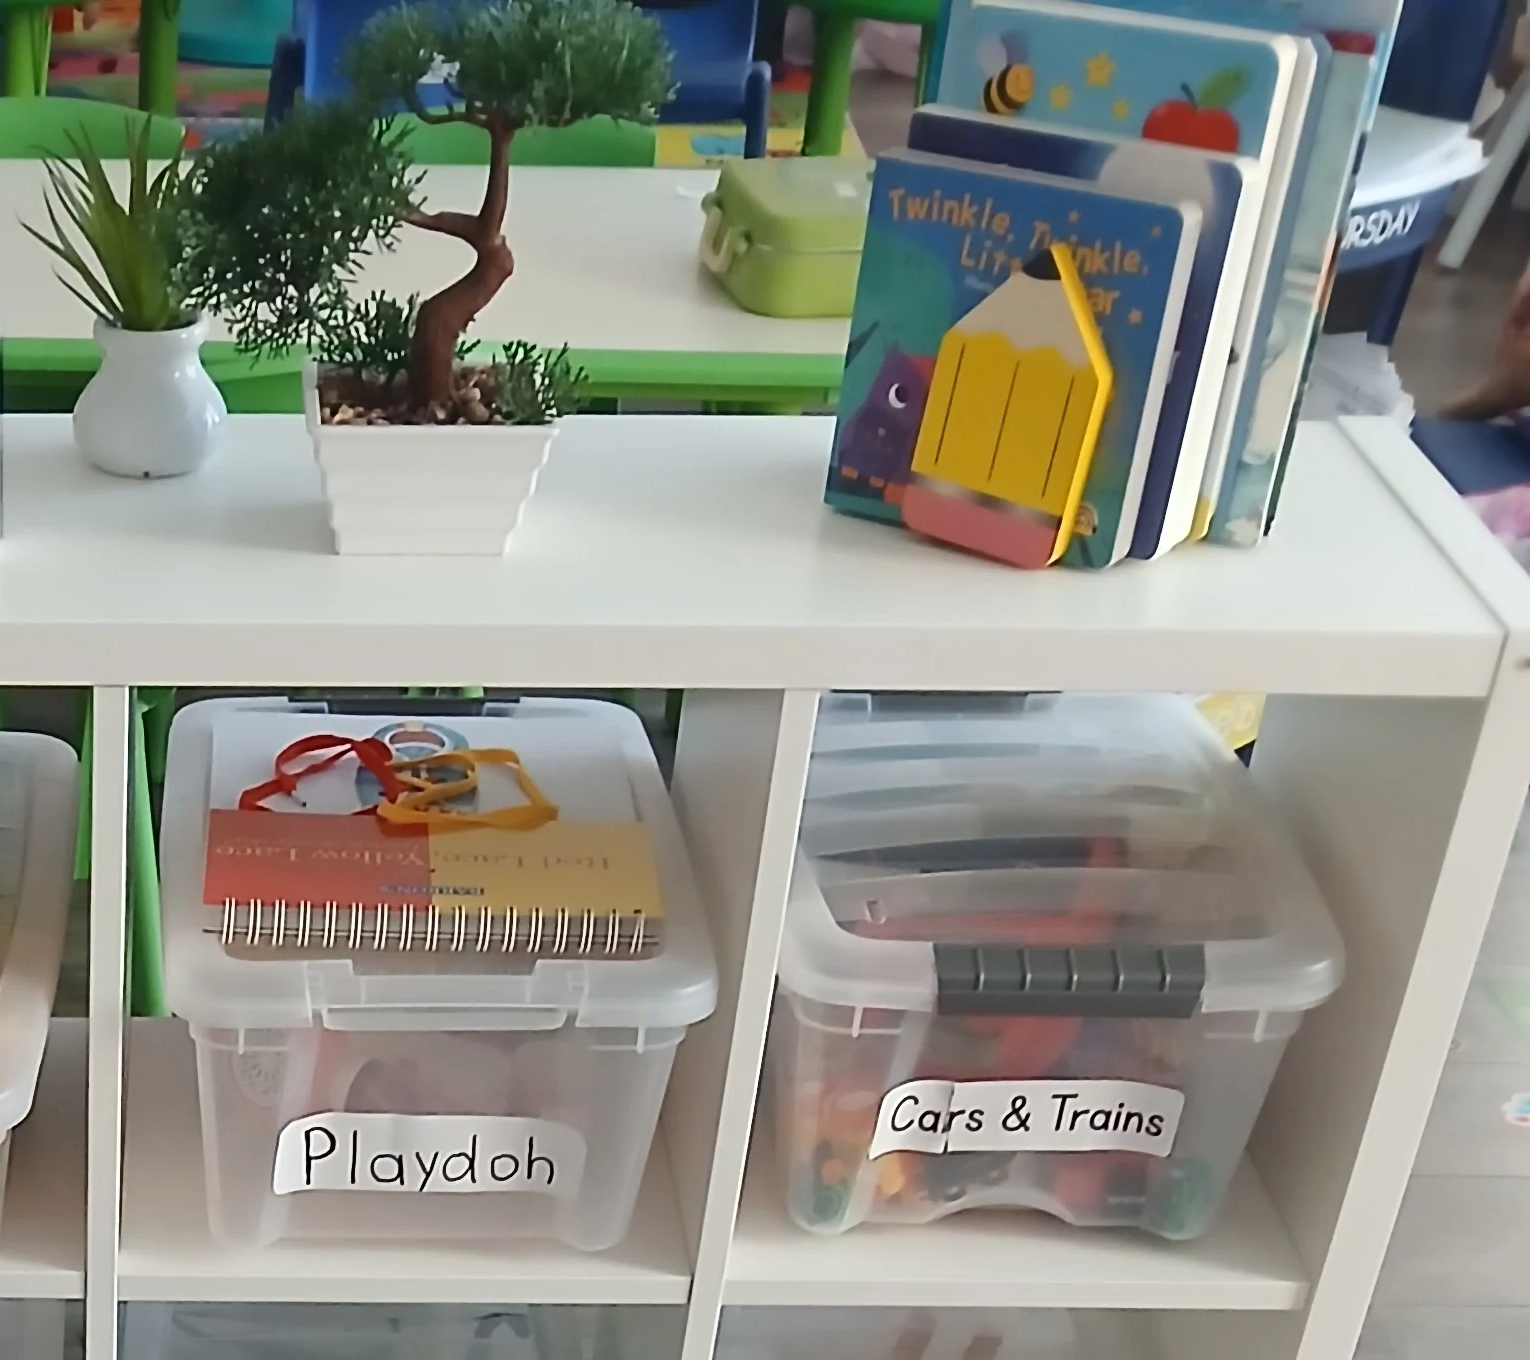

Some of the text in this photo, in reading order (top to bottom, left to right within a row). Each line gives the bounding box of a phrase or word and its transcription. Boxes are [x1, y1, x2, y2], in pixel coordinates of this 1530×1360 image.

[888, 187, 1015, 244] Twinkle,
[1341, 200, 1420, 250] RSDAY
[890, 1093, 1165, 1137] Cars & Trains
[304, 1126, 555, 1192] Playdoh
